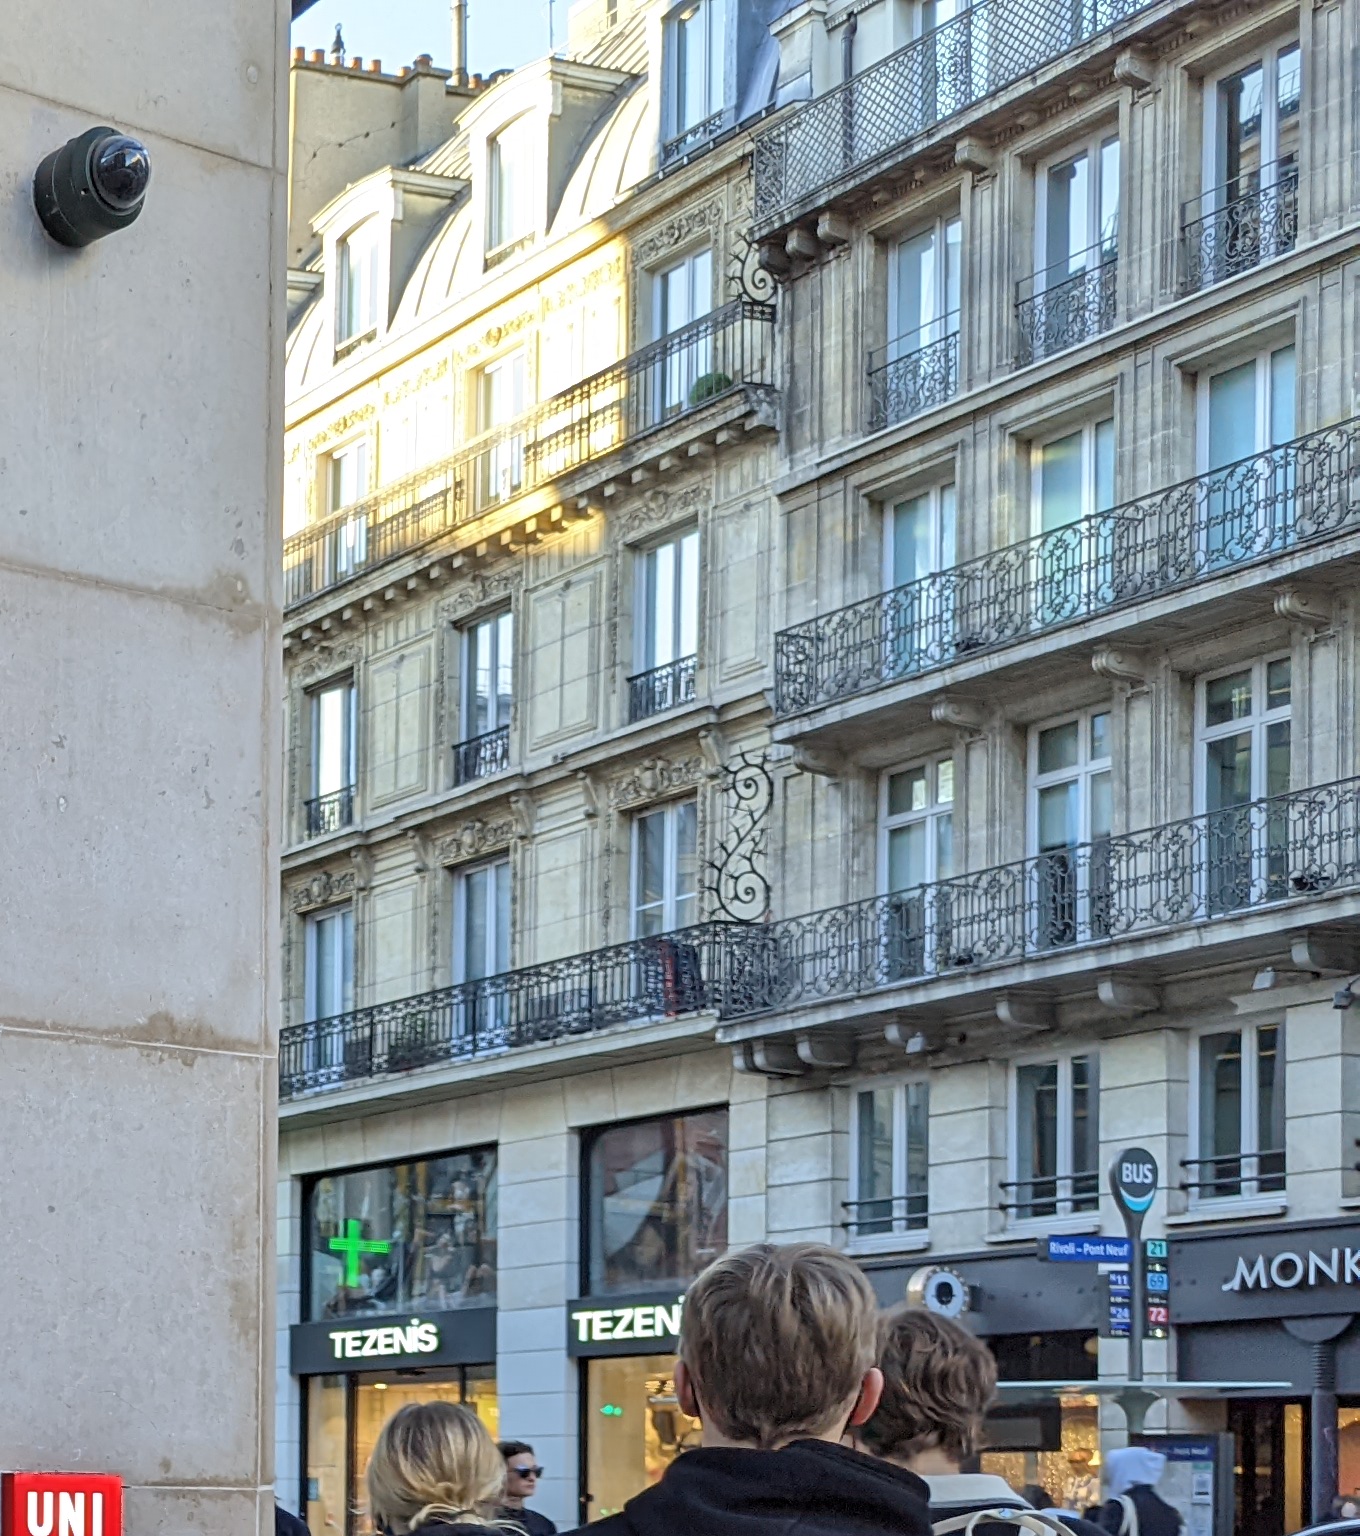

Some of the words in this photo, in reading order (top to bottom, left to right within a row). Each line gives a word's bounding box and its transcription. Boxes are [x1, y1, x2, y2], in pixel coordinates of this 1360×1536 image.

[1122, 1162, 1153, 1184] BUS
[1050, 1242, 1075, 1254] Rivoli
[1083, 1243, 1105, 1255] Pont
[1106, 1243, 1128, 1256] Neuf
[1150, 1243, 1164, 1255] 21
[1150, 1276, 1164, 1288] 69
[1149, 1308, 1167, 1321] 72
